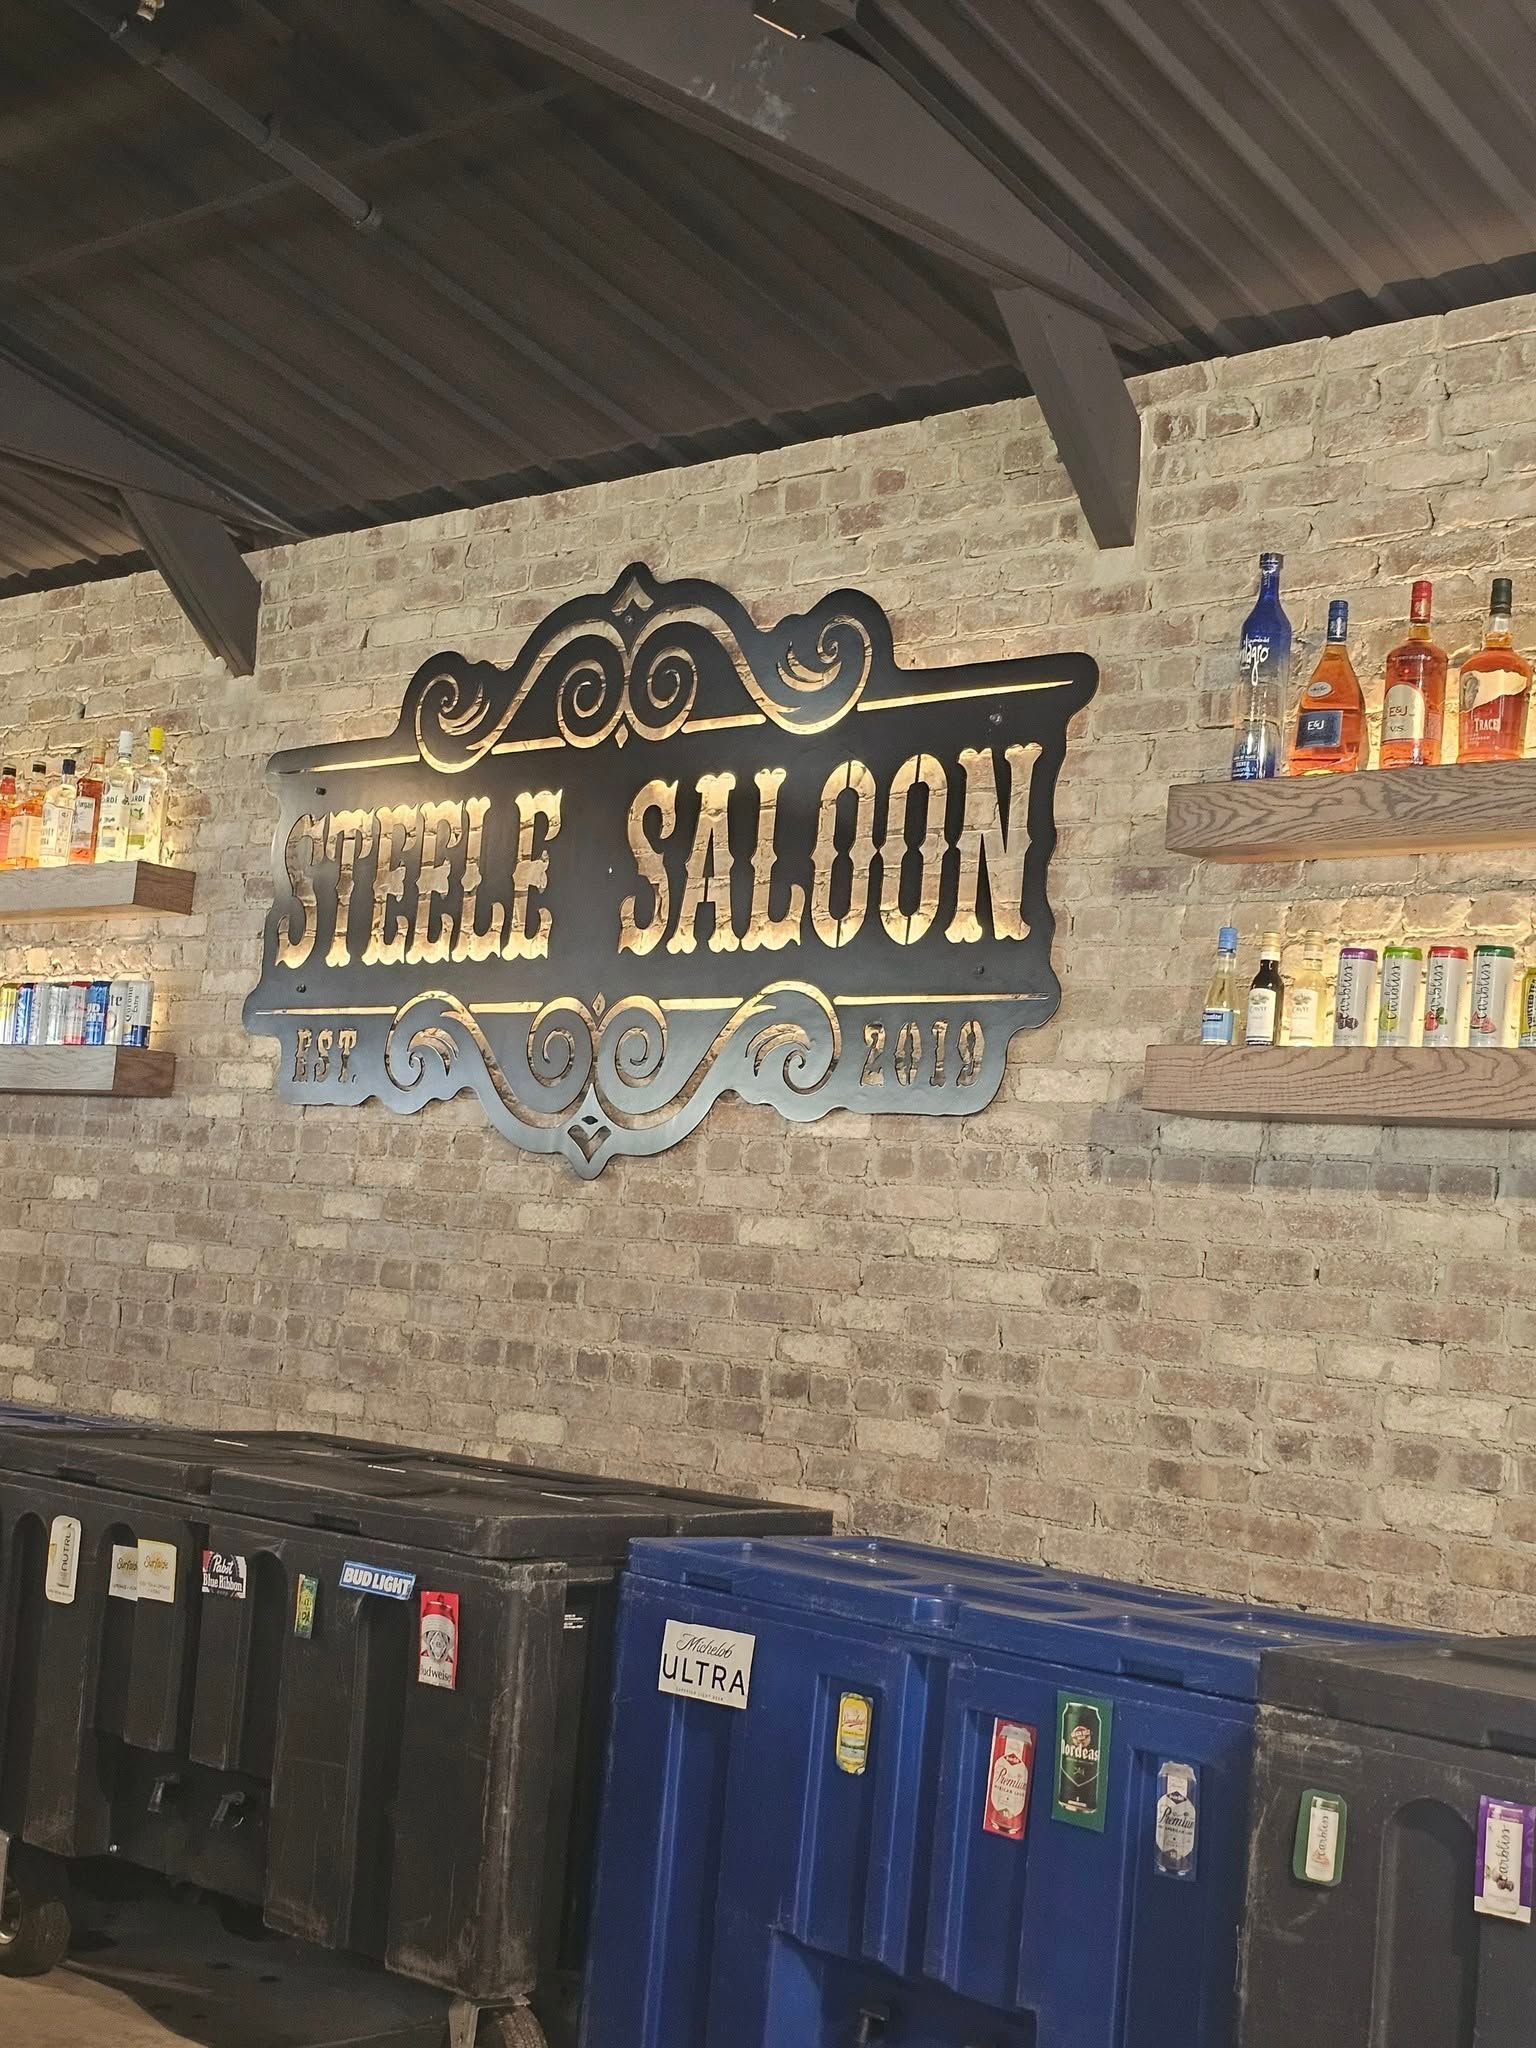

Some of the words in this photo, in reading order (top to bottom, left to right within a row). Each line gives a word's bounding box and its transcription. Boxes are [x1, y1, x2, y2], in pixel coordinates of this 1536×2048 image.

[1389, 706, 1408, 717] E&J
[1307, 720, 1325, 731] E&J
[275, 788, 562, 968] STEELE
[618, 742, 1043, 956] SALOON
[291, 1027, 359, 1083] EST.
[858, 1018, 984, 1088] 2019
[211, 1554, 235, 1575] Pabst
[203, 1573, 219, 1588] Blue
[219, 1575, 243, 1592] Ribbon
[342, 1567, 373, 1587] BUD
[372, 1573, 411, 1595] LIGHT
[675, 1633, 737, 1659] Michelob
[661, 1653, 746, 1696] ULTRA
[1061, 1739, 1099, 1762] ordeas
